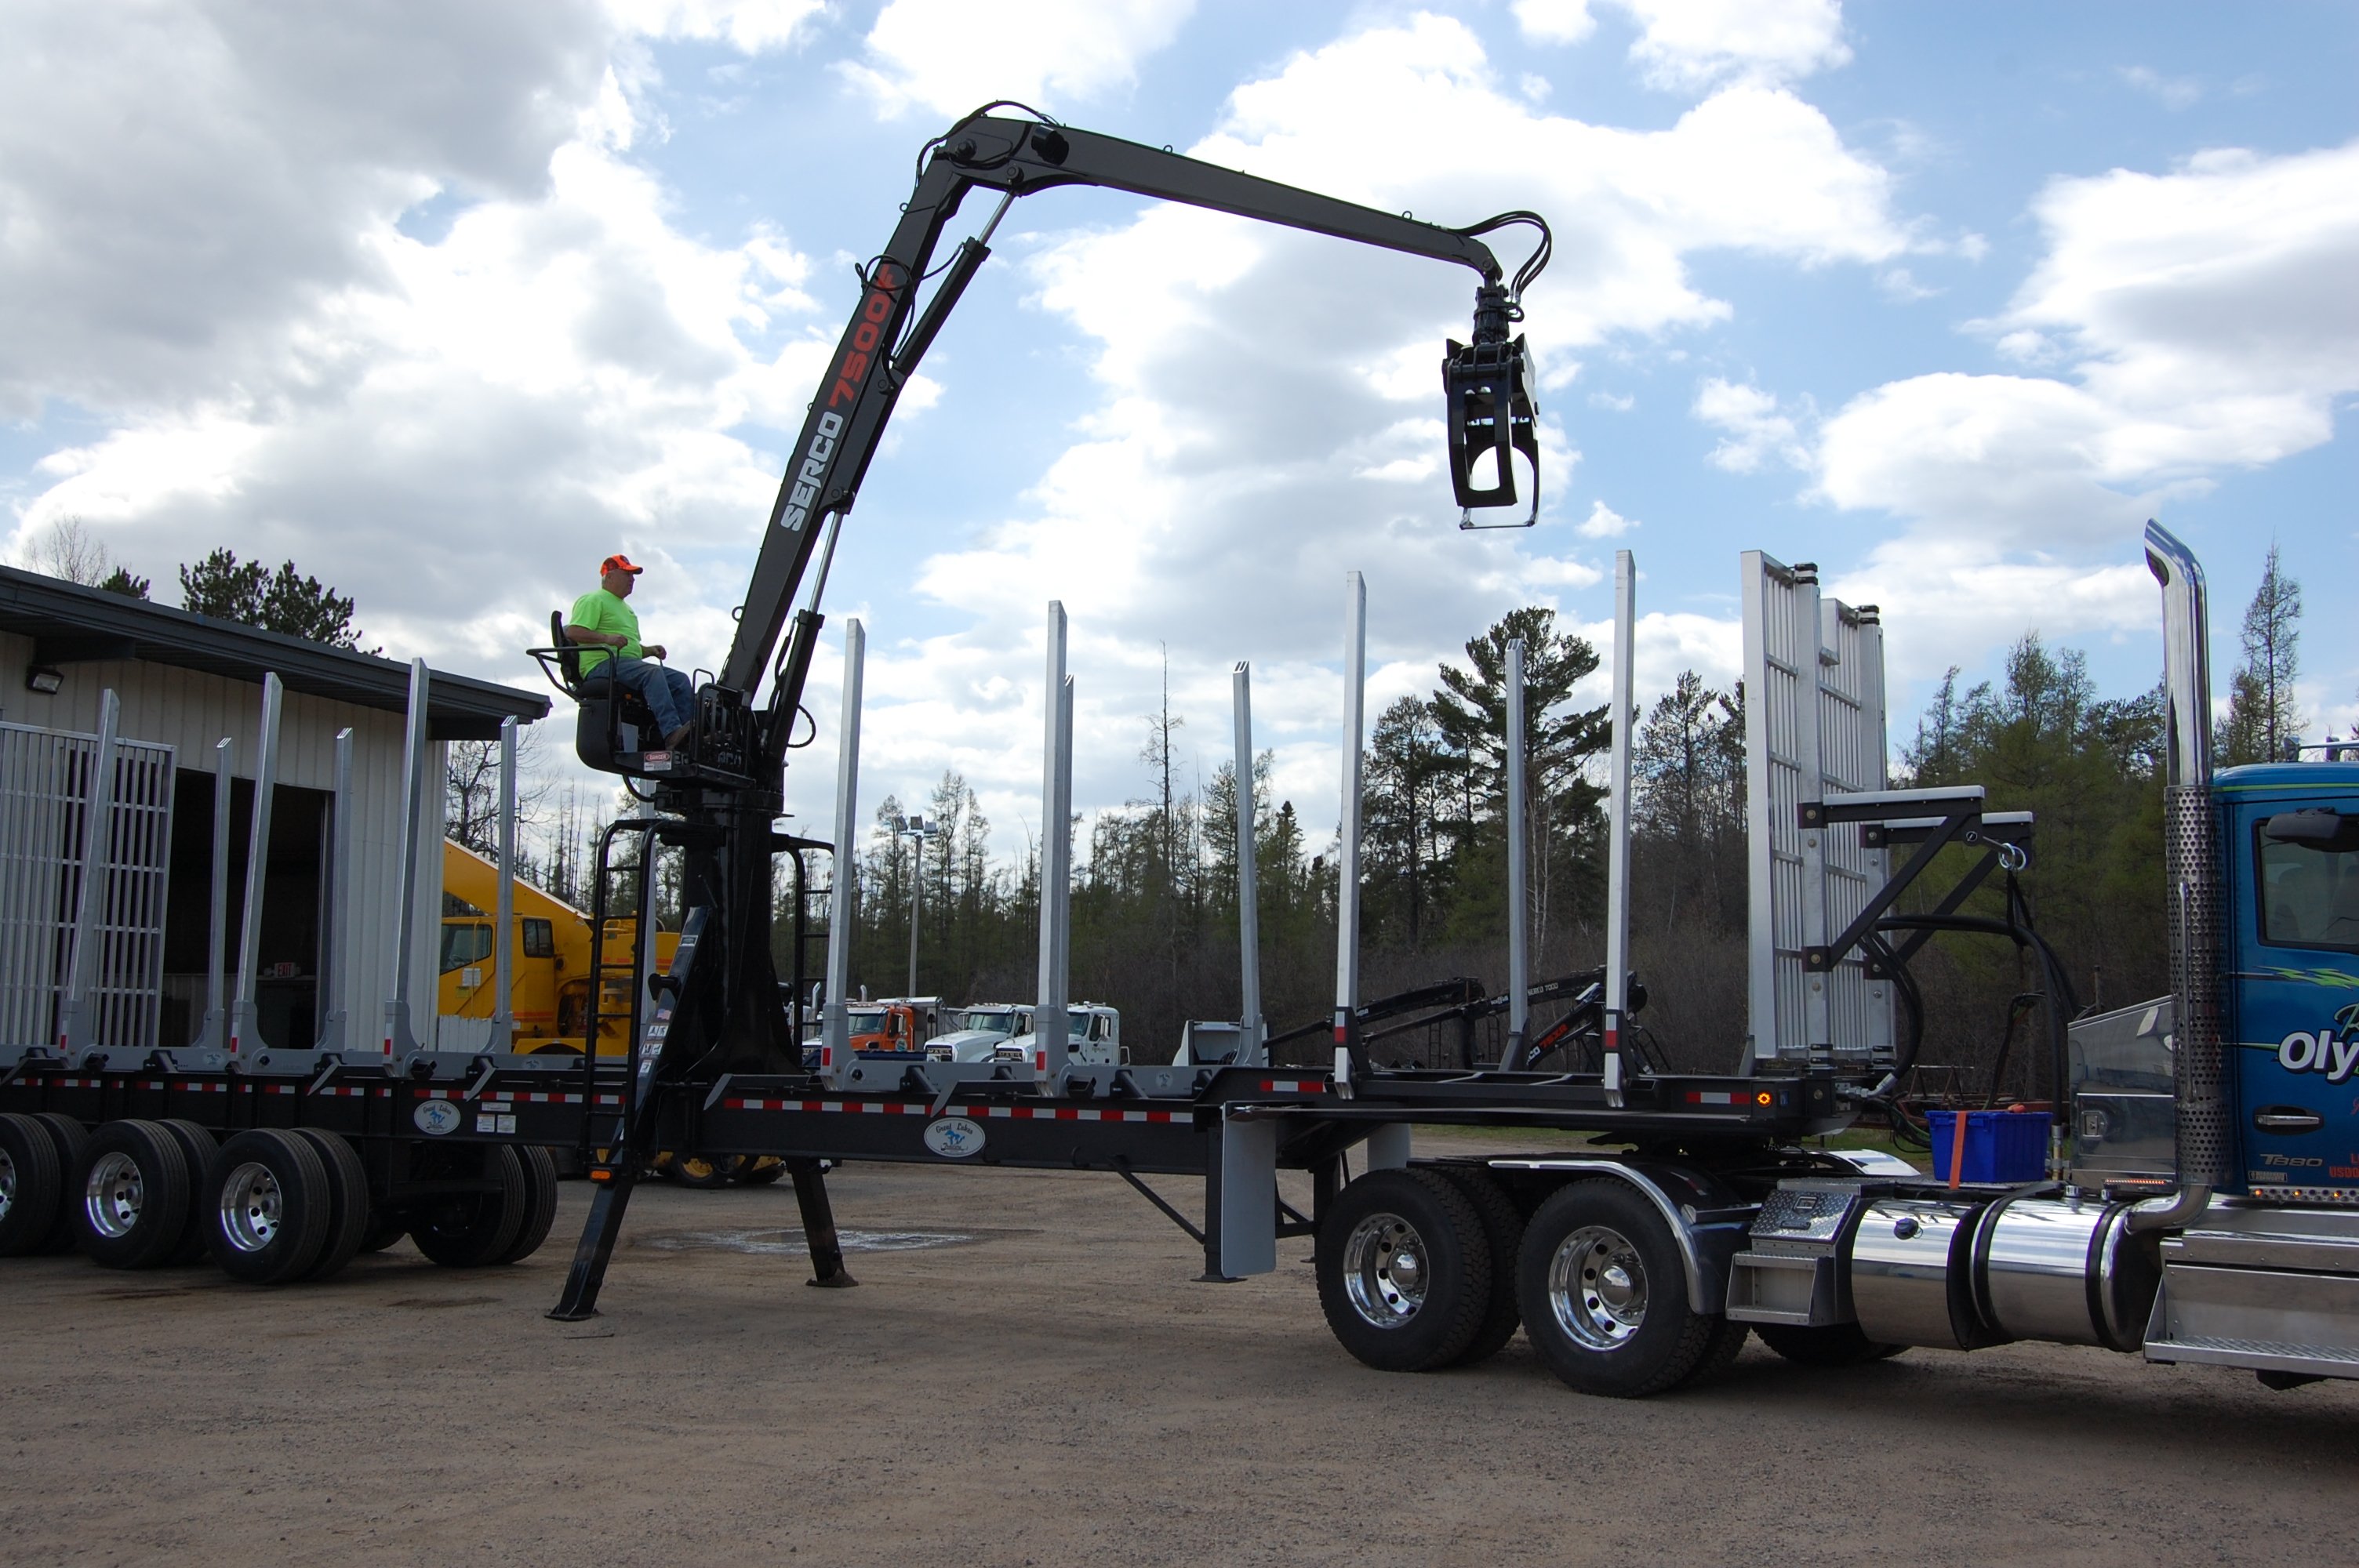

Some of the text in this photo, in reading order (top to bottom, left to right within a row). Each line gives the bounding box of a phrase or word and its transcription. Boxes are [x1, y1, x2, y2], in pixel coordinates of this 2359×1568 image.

[780, 411, 844, 532] SERCO
[278, 964, 293, 977] EXIT
[936, 1123, 973, 1134] Great Lakes
[2259, 1153, 2324, 1167] T880
